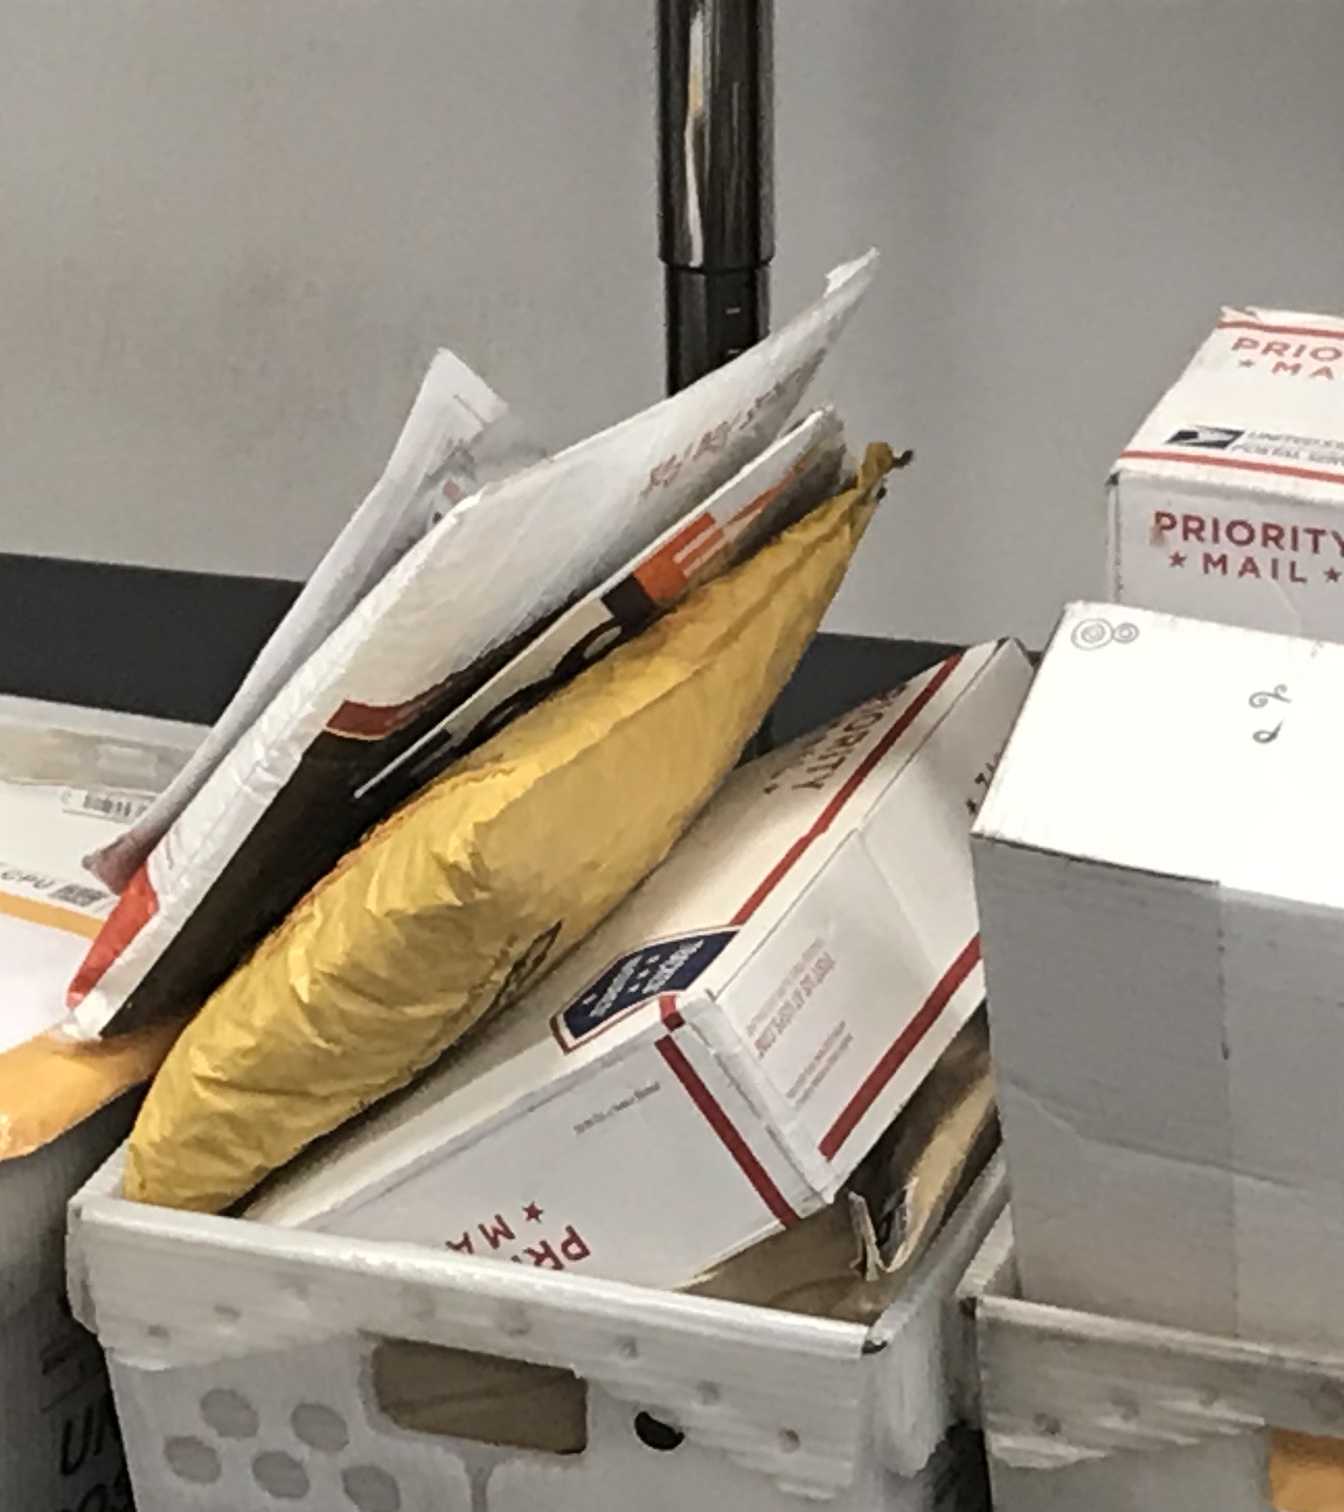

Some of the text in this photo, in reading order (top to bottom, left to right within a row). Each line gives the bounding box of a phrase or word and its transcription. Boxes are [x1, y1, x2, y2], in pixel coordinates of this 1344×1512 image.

[1201, 551, 1309, 584] MAIL
[0, 870, 57, 890] CPU
[510, 1224, 591, 1272] PR
